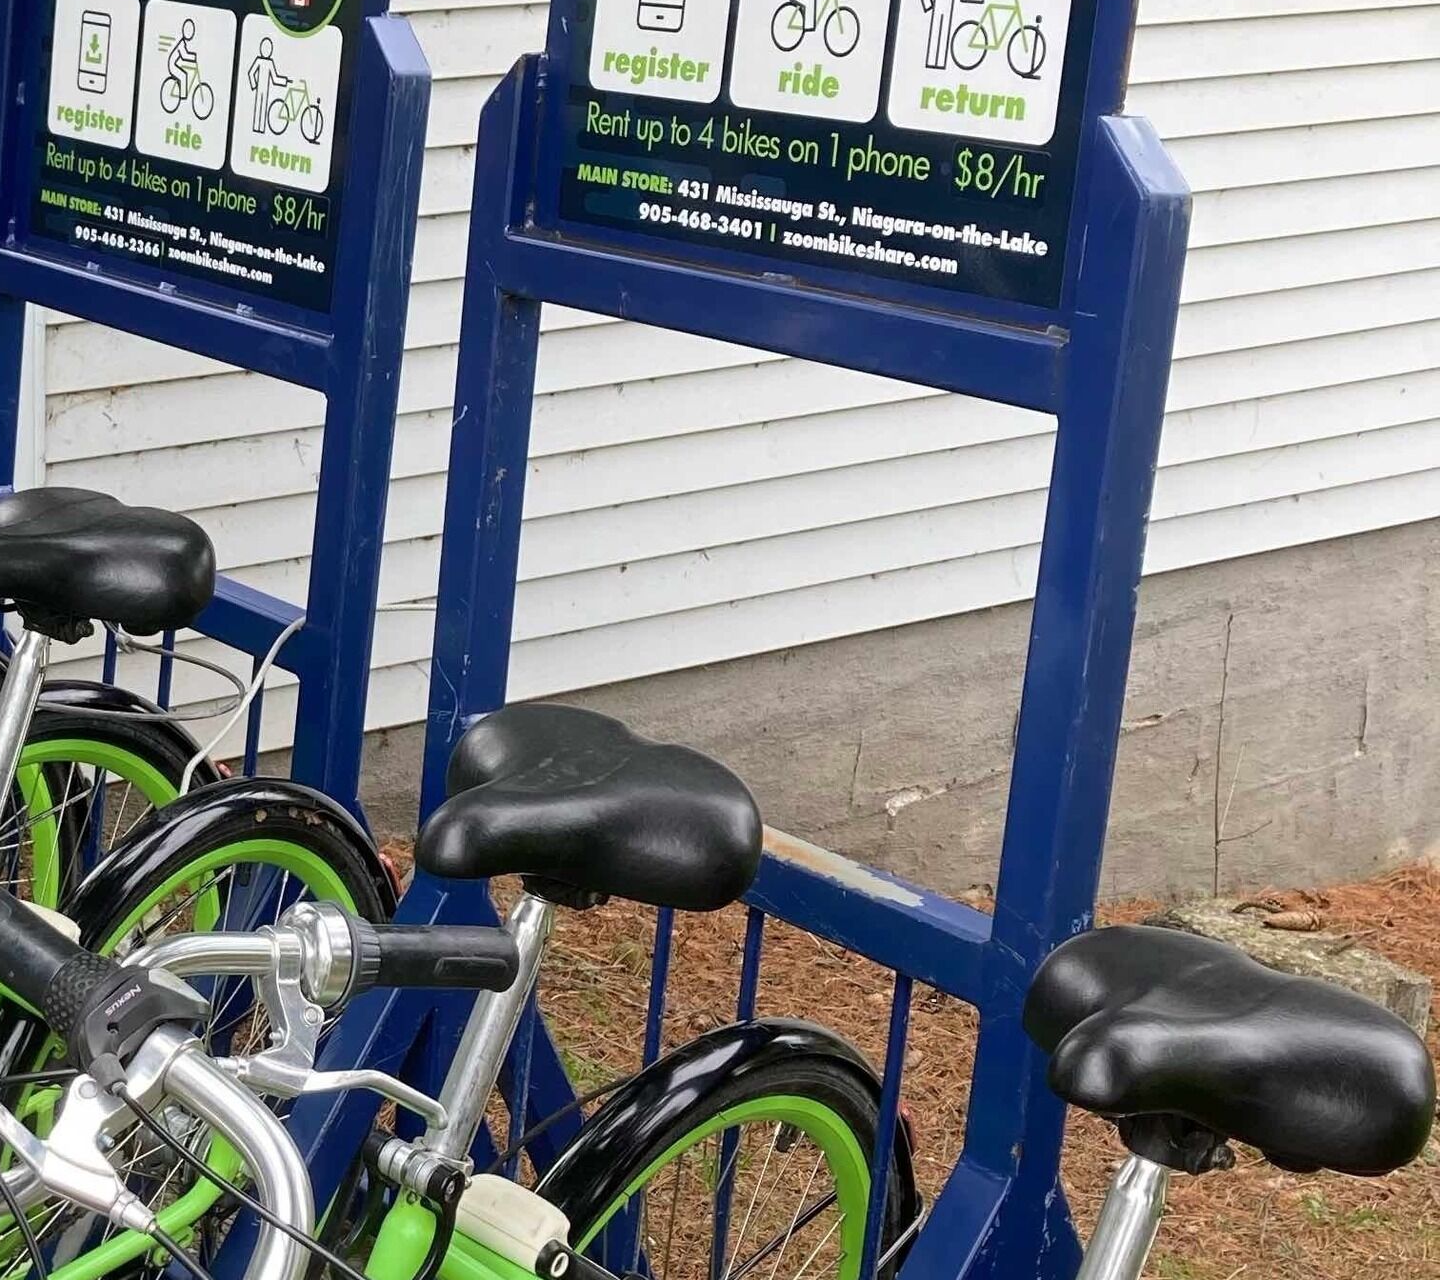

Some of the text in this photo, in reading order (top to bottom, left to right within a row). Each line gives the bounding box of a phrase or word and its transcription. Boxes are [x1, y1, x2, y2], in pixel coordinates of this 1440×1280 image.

[603, 47, 710, 84] register
[777, 63, 840, 100] ride
[56, 104, 124, 134] register
[920, 83, 1026, 122] return
[165, 122, 203, 152] ride
[586, 100, 1045, 199] Rent up to 4 bikes on 1 phone $8/hr
[249, 144, 312, 175] return
[45, 141, 325, 232] Rent up to 4 bikes on 1 phone $8/hr
[577, 163, 1048, 257] MAIN STORE: 431 Mississauga St., Niagara-on-the-Lake
[40, 189, 68, 208] MAIN
[69, 195, 102, 217] STORE:
[103, 205, 124, 222] 431
[127, 210, 188, 241] Mississauga
[209, 230, 325, 274] Niagara-on-the-Lake
[638, 202, 763, 240] 905-468-3401
[782, 231, 959, 275] zoombikeshare.com
[74, 225, 160, 258] 905-468-2366
[167, 246, 273, 285] zoombikeshare.com
[104, 983, 142, 1018] Nexus
